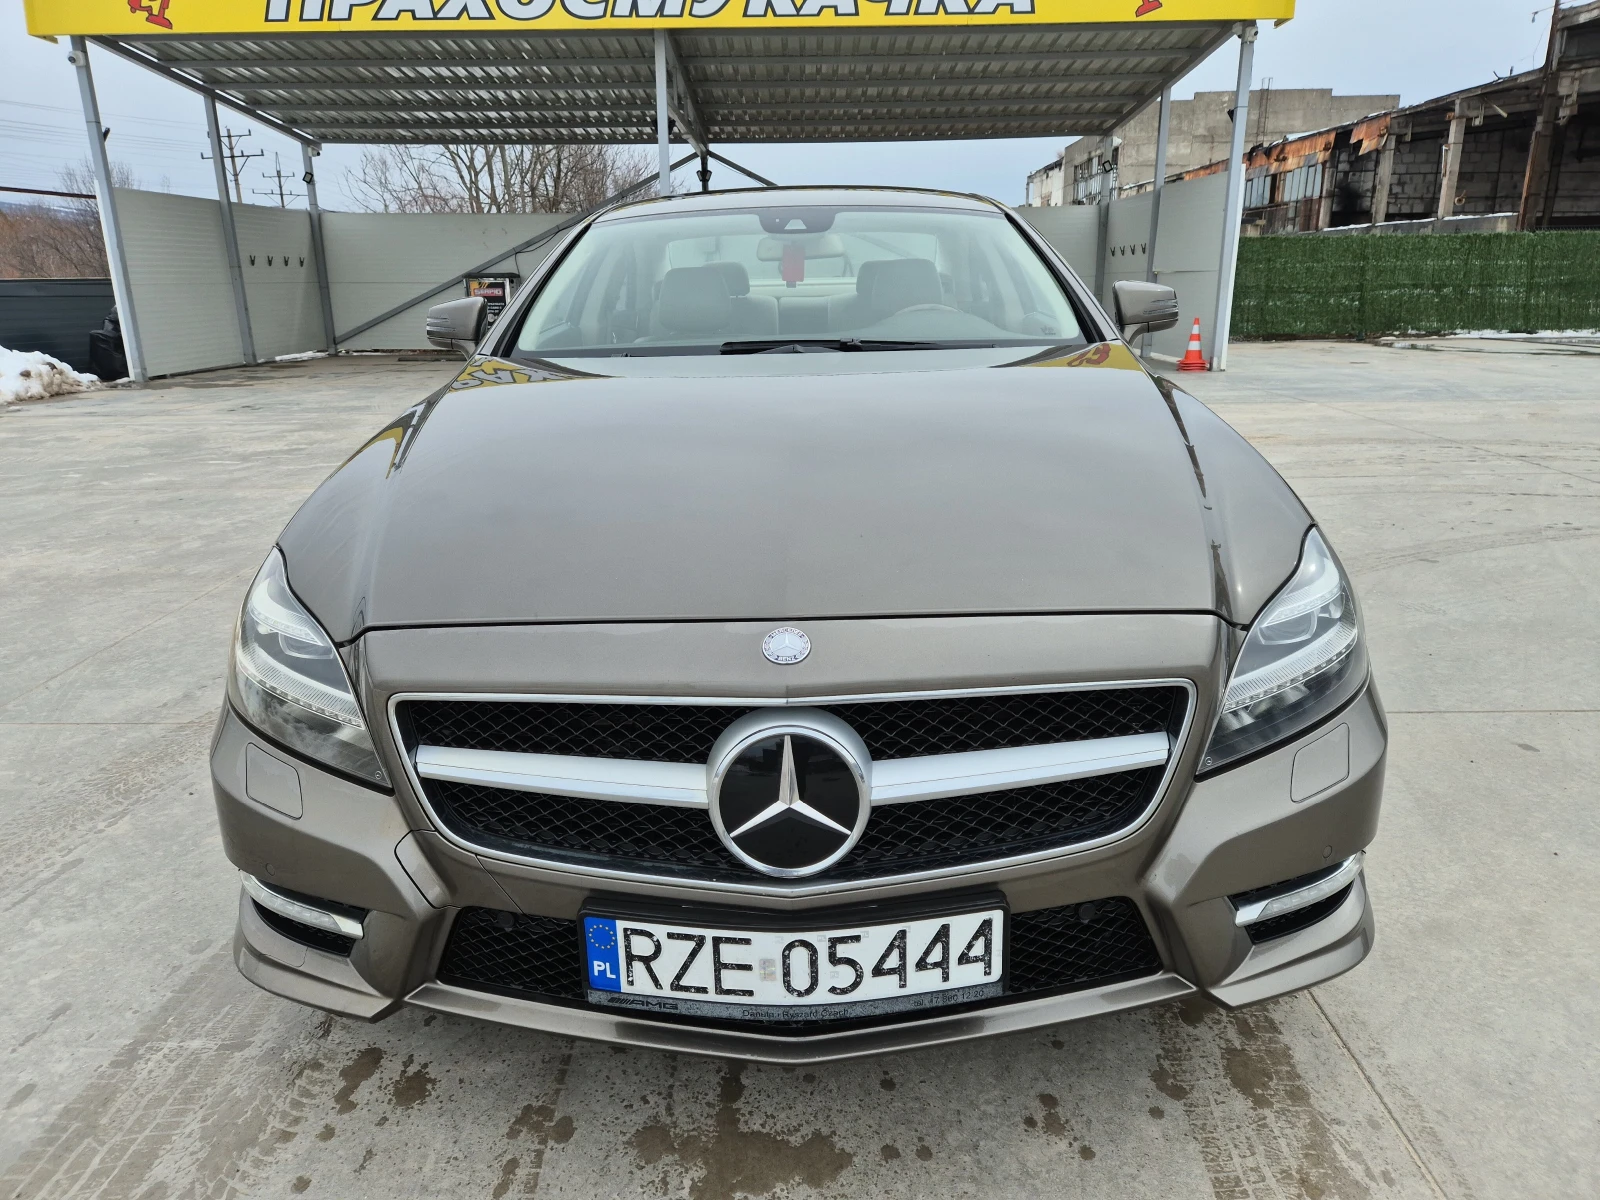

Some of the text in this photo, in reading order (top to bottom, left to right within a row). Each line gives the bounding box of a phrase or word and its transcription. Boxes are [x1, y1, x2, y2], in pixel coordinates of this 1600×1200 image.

[593, 961, 616, 979] PL
[623, 917, 993, 997] RZE 05444
